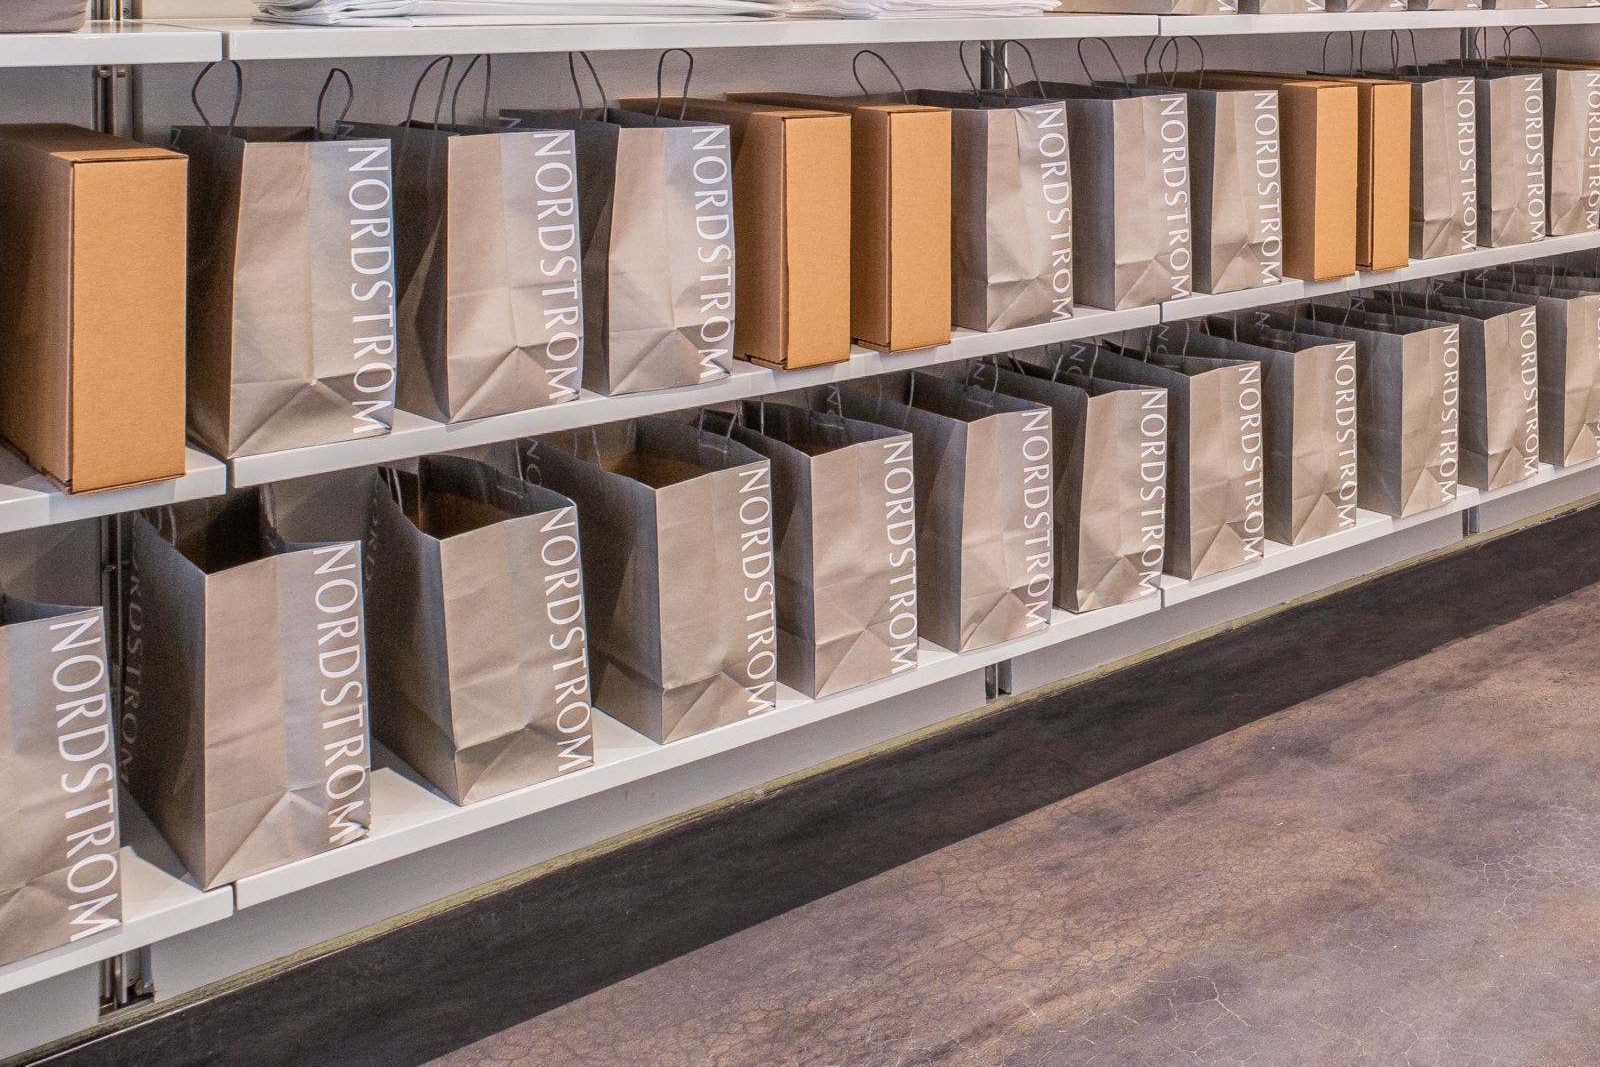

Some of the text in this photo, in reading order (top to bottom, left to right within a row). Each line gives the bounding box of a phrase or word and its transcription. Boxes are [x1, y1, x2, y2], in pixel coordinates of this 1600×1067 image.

[533, 132, 582, 402] NORDSTROM
[691, 127, 733, 380] NORDSTROM
[1036, 106, 1074, 323] NORDSTROM
[1159, 93, 1193, 301] NORDSTROM
[1254, 90, 1283, 285] NORDSTROM
[1456, 76, 1476, 251] NORDSTROM
[1525, 76, 1545, 242] NORDSTROM
[347, 144, 397, 434] NORDSTROM
[1520, 309, 1539, 477] NORDSTROM
[1020, 408, 1053, 630] NORDSTROM
[1140, 389, 1168, 597] NORDSTROM
[1238, 366, 1265, 563] NORDSTROM
[1335, 343, 1357, 529] NORDSTROM
[1440, 326, 1460, 503] NORDSTROM
[539, 506, 593, 772] NORDSTROM
[738, 465, 777, 716] NORDSTROM
[884, 439, 918, 675] NORDSTROM
[49, 610, 121, 942] NORDSTROM
[311, 541, 371, 846] NORDSTROM
